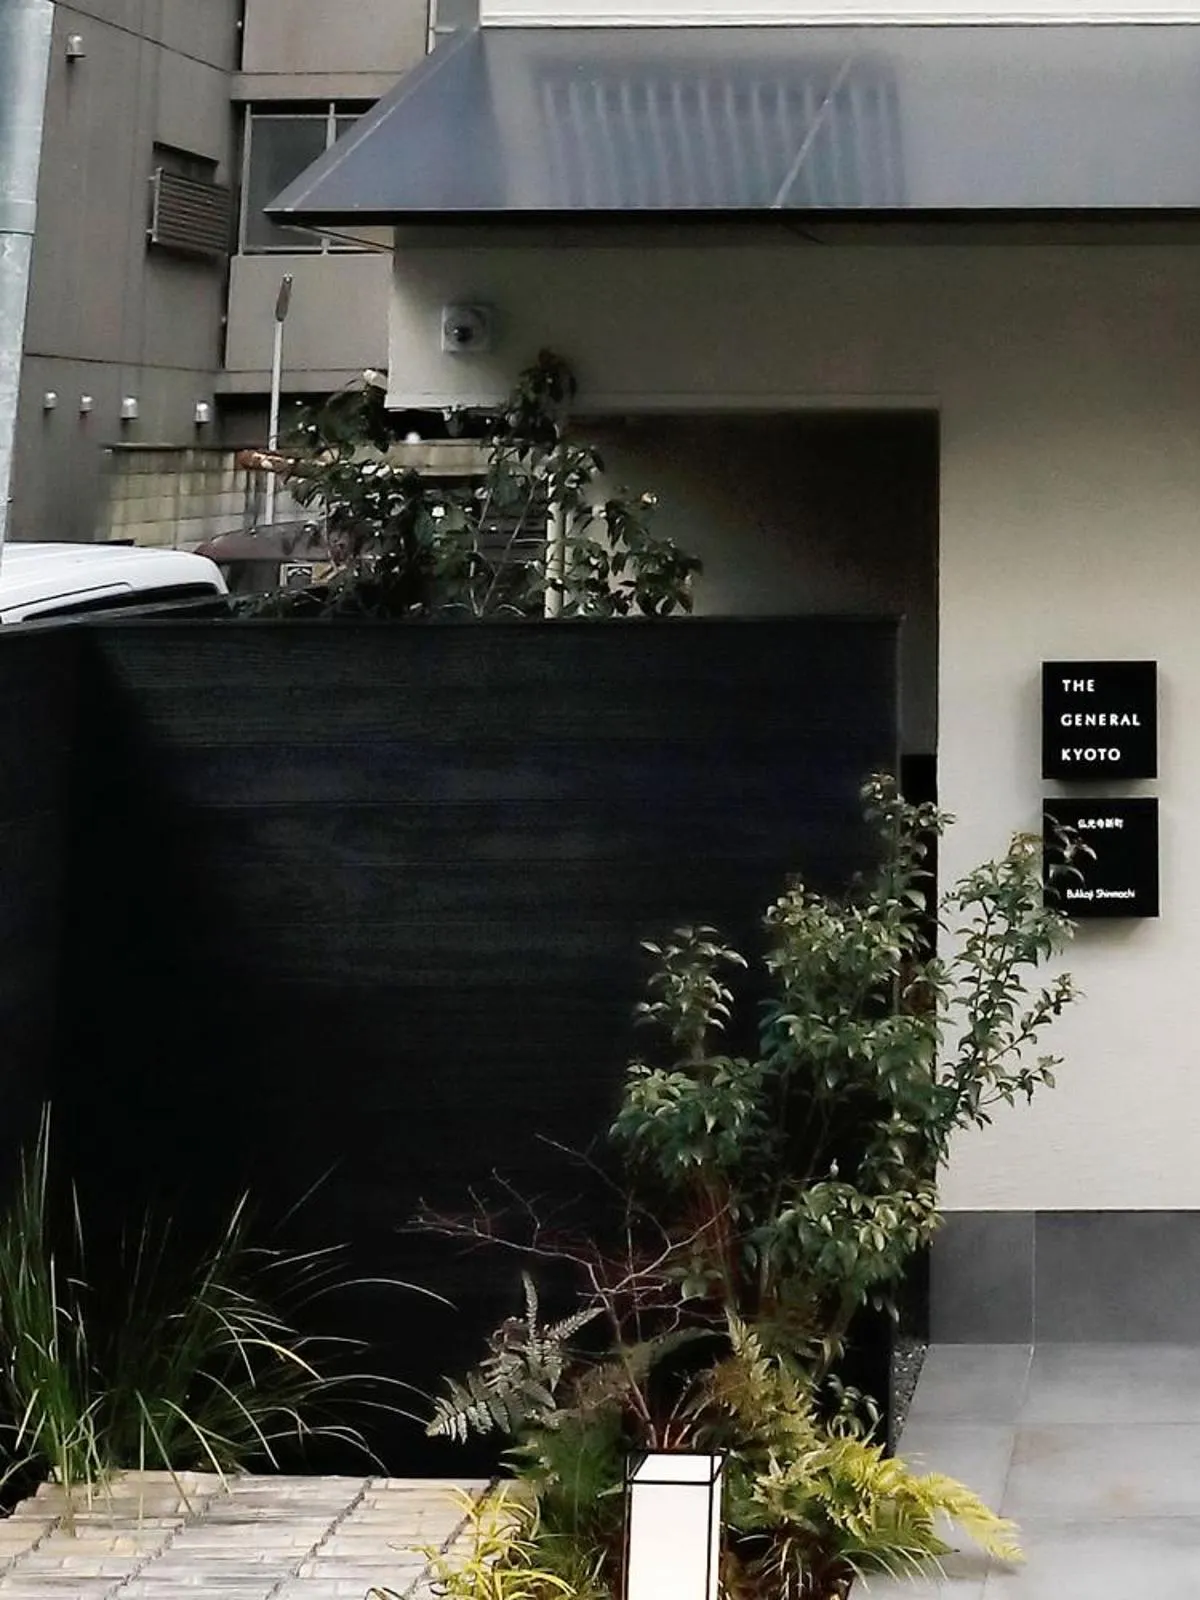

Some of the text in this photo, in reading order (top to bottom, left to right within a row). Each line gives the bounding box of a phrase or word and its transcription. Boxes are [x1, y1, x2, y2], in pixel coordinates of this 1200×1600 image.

[1061, 679, 1095, 693] THE
[1060, 713, 1141, 727] GENERAL
[1061, 747, 1121, 762] KYOTO
